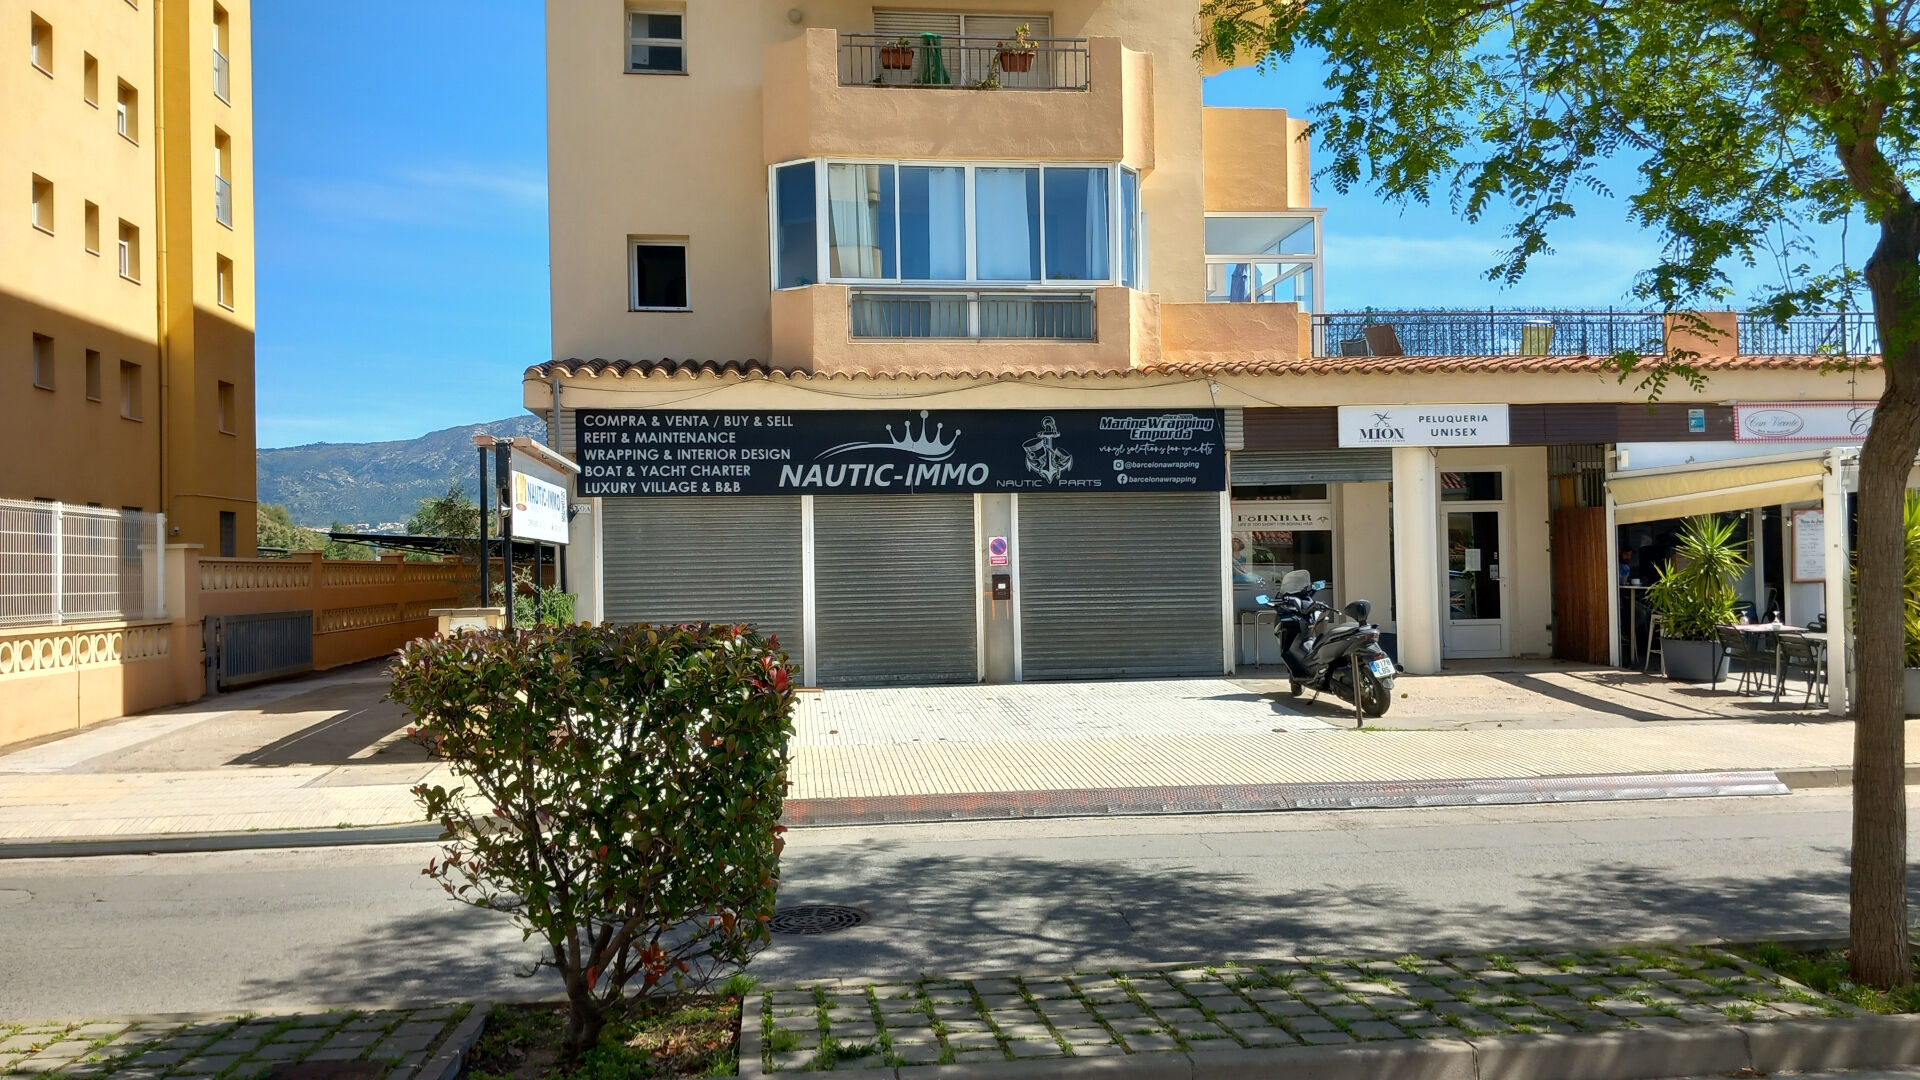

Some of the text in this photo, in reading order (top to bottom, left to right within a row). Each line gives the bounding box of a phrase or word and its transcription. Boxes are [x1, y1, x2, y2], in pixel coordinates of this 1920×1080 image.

[584, 414, 794, 428] COMPRA & VENTA / BUY & SELL
[1418, 414, 1489, 424] PELUQUERIA
[584, 431, 736, 444] REFIT & MAINTENANCE
[1359, 428, 1405, 440] MION
[1430, 428, 1477, 437] UNISEX
[584, 448, 791, 461] WRAPPING & INTERIOR DESIGN
[1099, 442, 1216, 456] vinyl solutions for yachts
[585, 464, 751, 478] BOAT & YACHT CHARTER
[1125, 461, 1200, 469] @barcelonawrapping
[778, 463, 989, 487] NAUTIC-IMMO
[1129, 476, 1197, 484] barcelonawrapping
[585, 481, 741, 494] LUXURY VILLAGE & B&B
[996, 479, 1102, 488] NAUTIC PARTS
